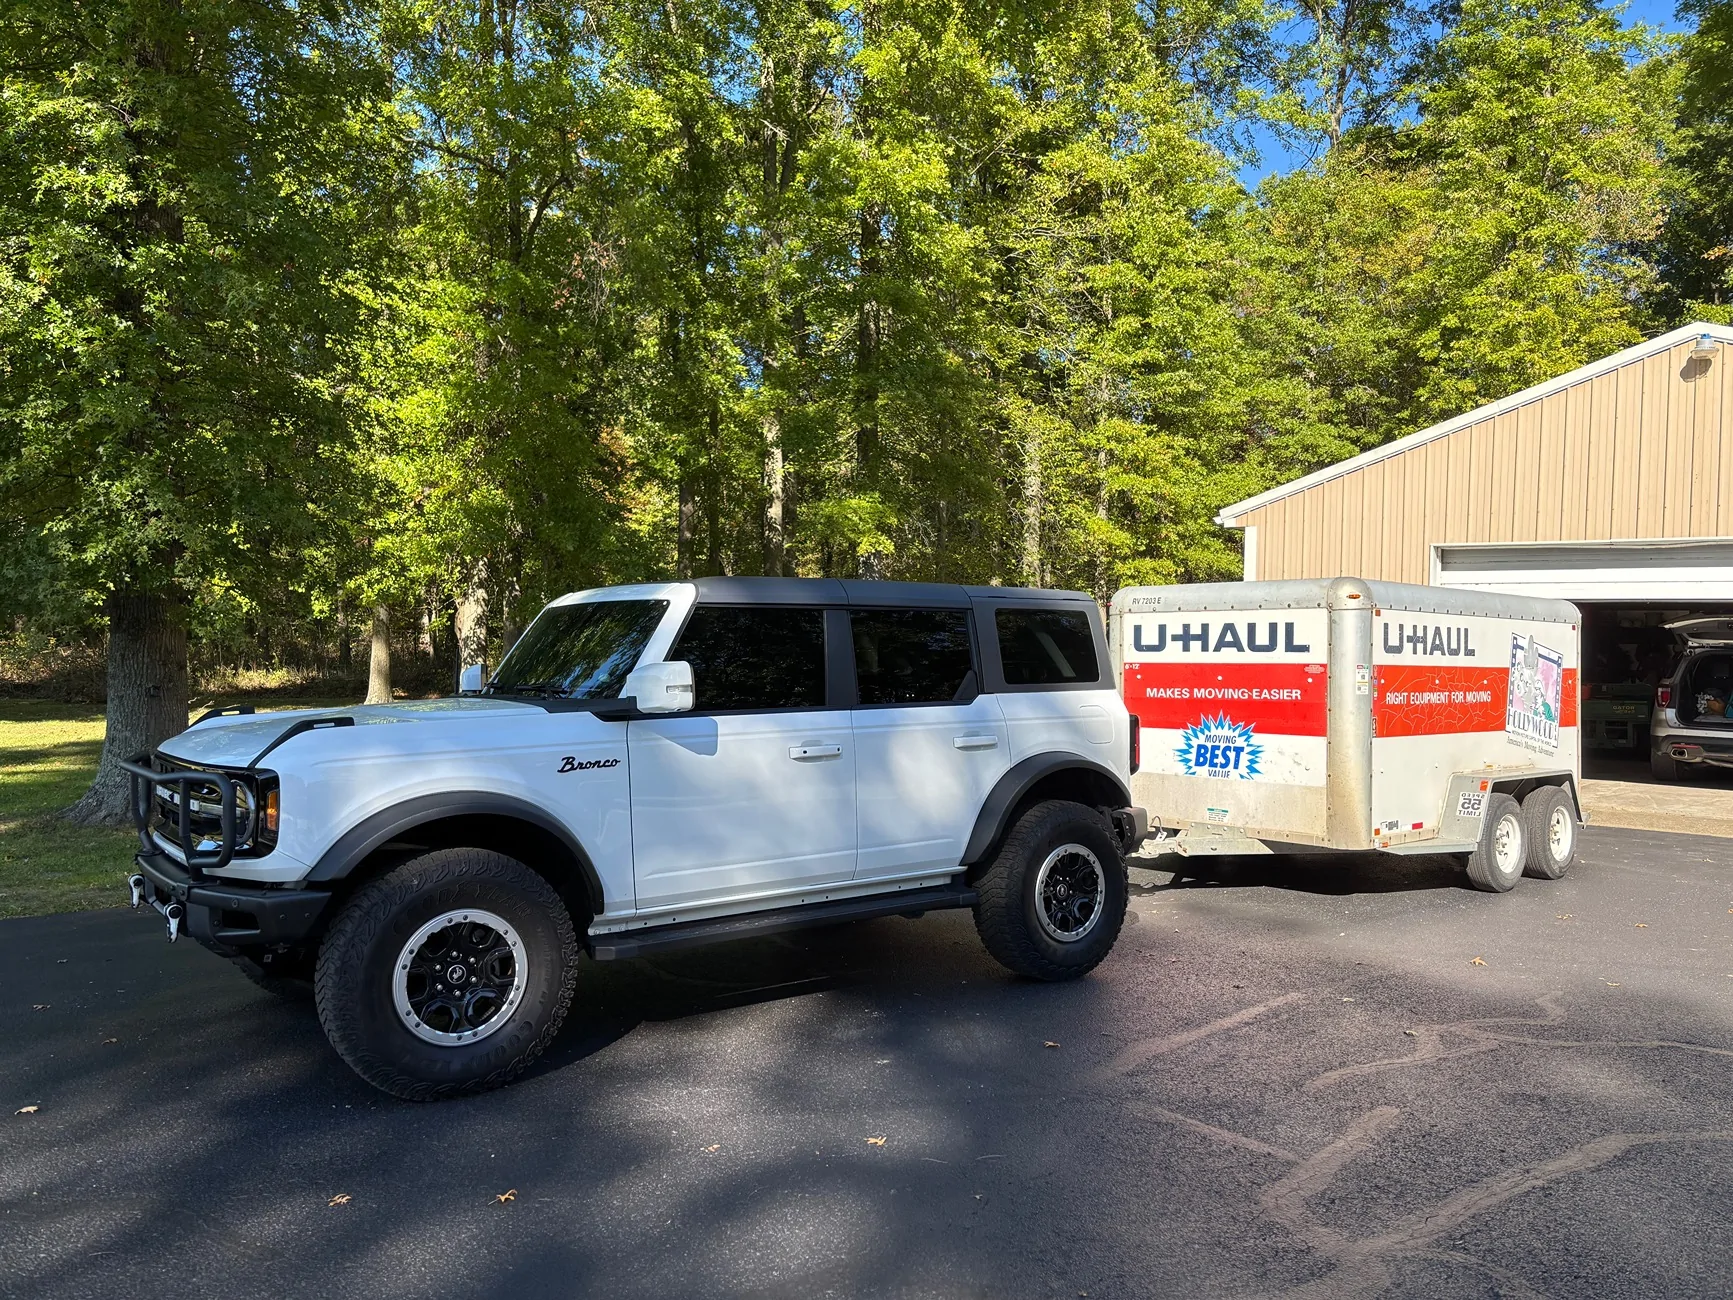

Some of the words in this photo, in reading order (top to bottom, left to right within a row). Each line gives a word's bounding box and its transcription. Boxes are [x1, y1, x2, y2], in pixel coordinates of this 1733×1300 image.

[1133, 622, 1310, 653] U-HAUL
[1383, 622, 1476, 657] U-HAUL
[1146, 687, 1190, 699] MAKES
[1193, 687, 1249, 700] MOVING
[1252, 688, 1302, 700] EASIER
[1386, 692, 1408, 705] RIGHT
[1410, 691, 1449, 705] EQUIPMENT
[1451, 691, 1464, 704] FOR
[1466, 690, 1491, 704] MOVING
[1507, 708, 1554, 740] HOLLYWOOD
[1204, 734, 1237, 745] MOVING
[557, 756, 621, 773] Bronco
[1194, 744, 1245, 770] BEST
